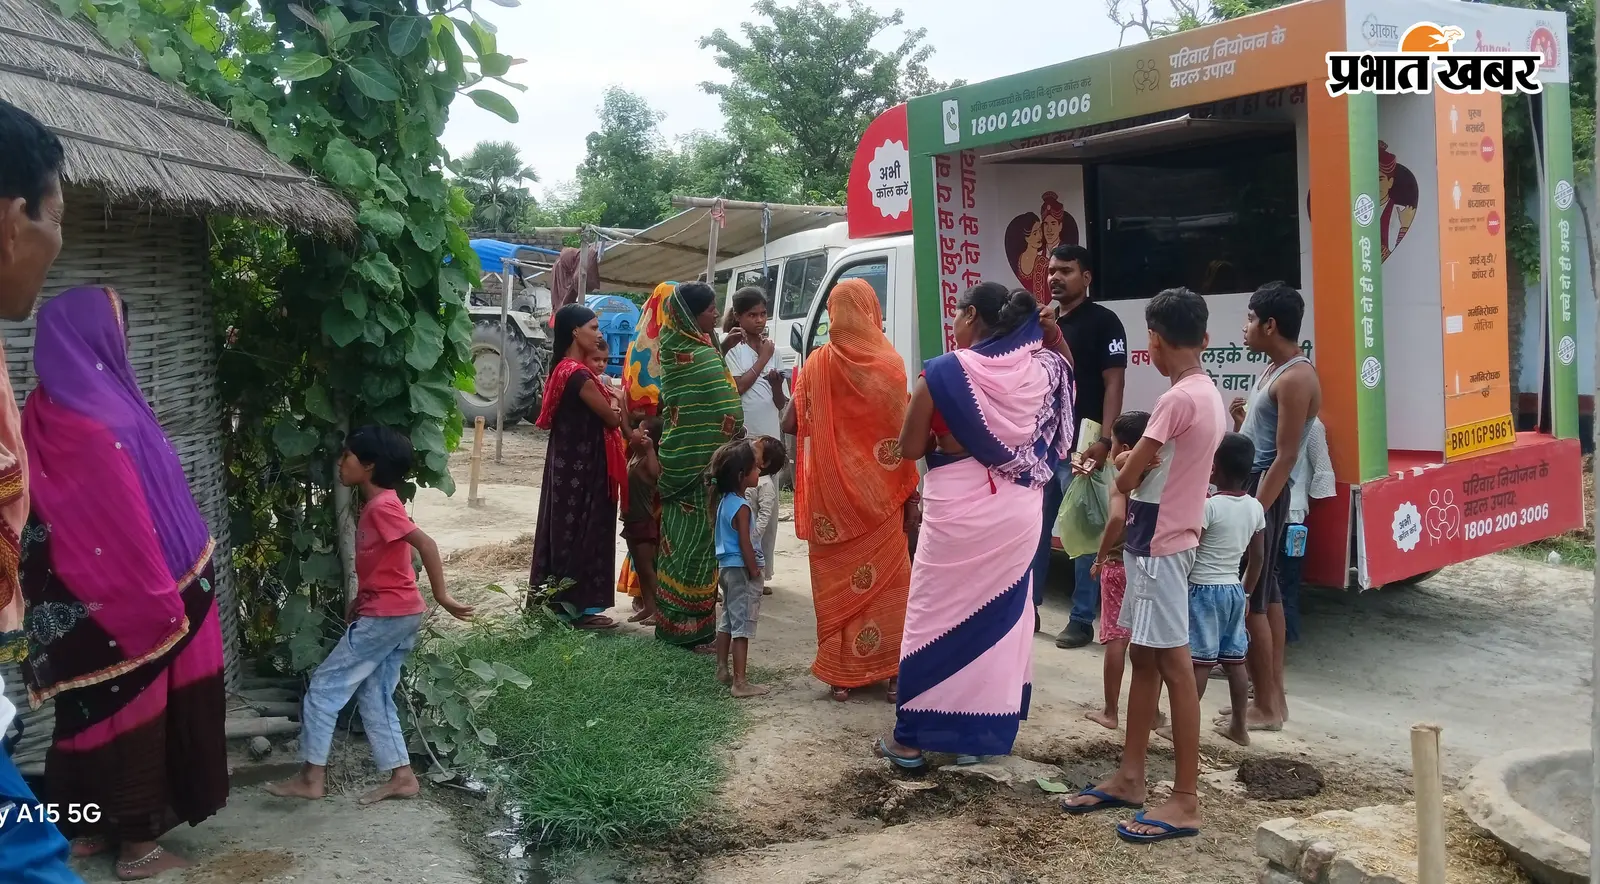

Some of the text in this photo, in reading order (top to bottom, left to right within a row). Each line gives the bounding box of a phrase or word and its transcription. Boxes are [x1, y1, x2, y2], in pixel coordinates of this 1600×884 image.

[1169, 24, 1286, 69] परिवार नियोजन के
[1170, 60, 1236, 88] सरल उपाय
[971, 112, 1007, 136] 1800
[1011, 104, 1042, 127] 200
[1046, 93, 1091, 120] 3006
[880, 160, 901, 180] अभी
[876, 180, 909, 199] कॉल करें
[1472, 182, 1490, 194] महिला
[958, 213, 979, 236] से
[939, 234, 962, 275] खुद
[960, 240, 980, 264] दो
[1359, 236, 1371, 272] अच्छे
[1558, 256, 1571, 271] ही
[1359, 276, 1374, 293] ही
[1560, 274, 1571, 290] दो
[942, 280, 958, 318] कर
[1360, 296, 1374, 313] दो
[1361, 316, 1374, 348] बच्चे
[1108, 338, 1124, 352] dkt
[1202, 342, 1243, 368] लड़के
[1452, 420, 1513, 450] BR01GP9861
[1462, 460, 1549, 496] परिवार नियोजन के
[1464, 498, 1488, 518] सरल
[1464, 503, 1549, 540] 1800 200 3006
